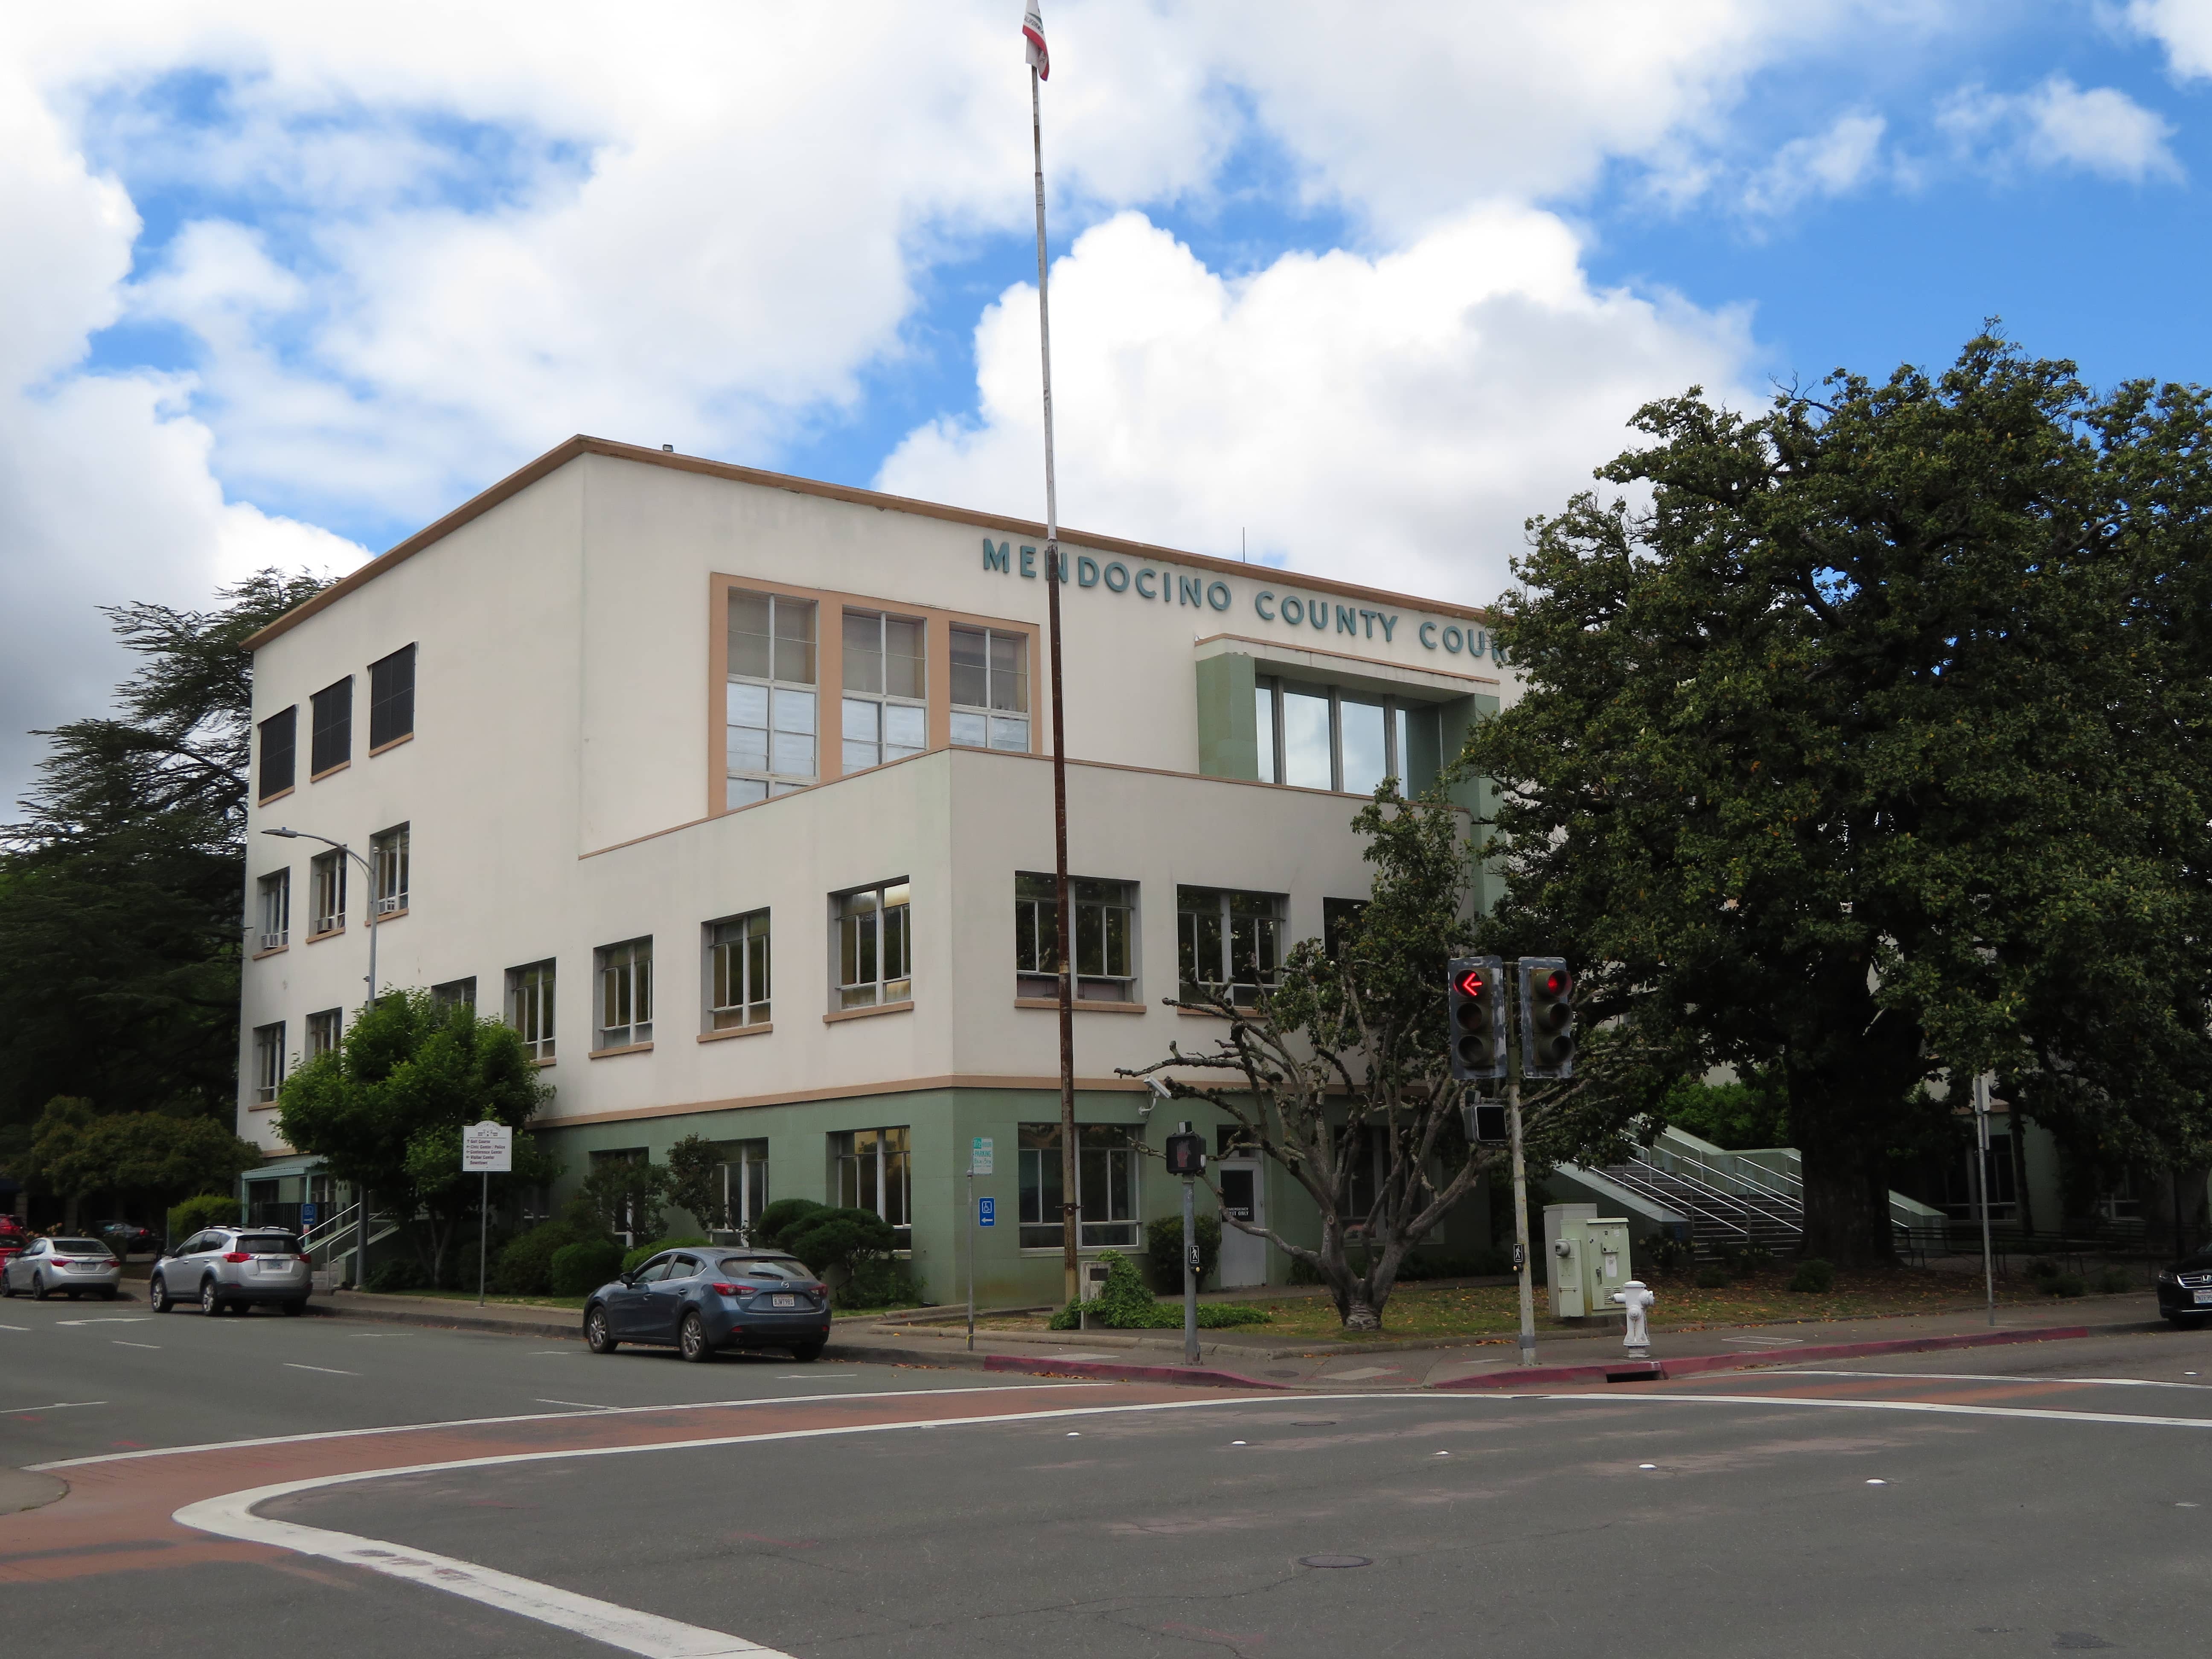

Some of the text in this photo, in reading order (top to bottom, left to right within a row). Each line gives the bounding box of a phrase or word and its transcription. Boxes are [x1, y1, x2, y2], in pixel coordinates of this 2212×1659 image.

[983, 538, 1508, 662] MENDOCINO COUNTY COUR
